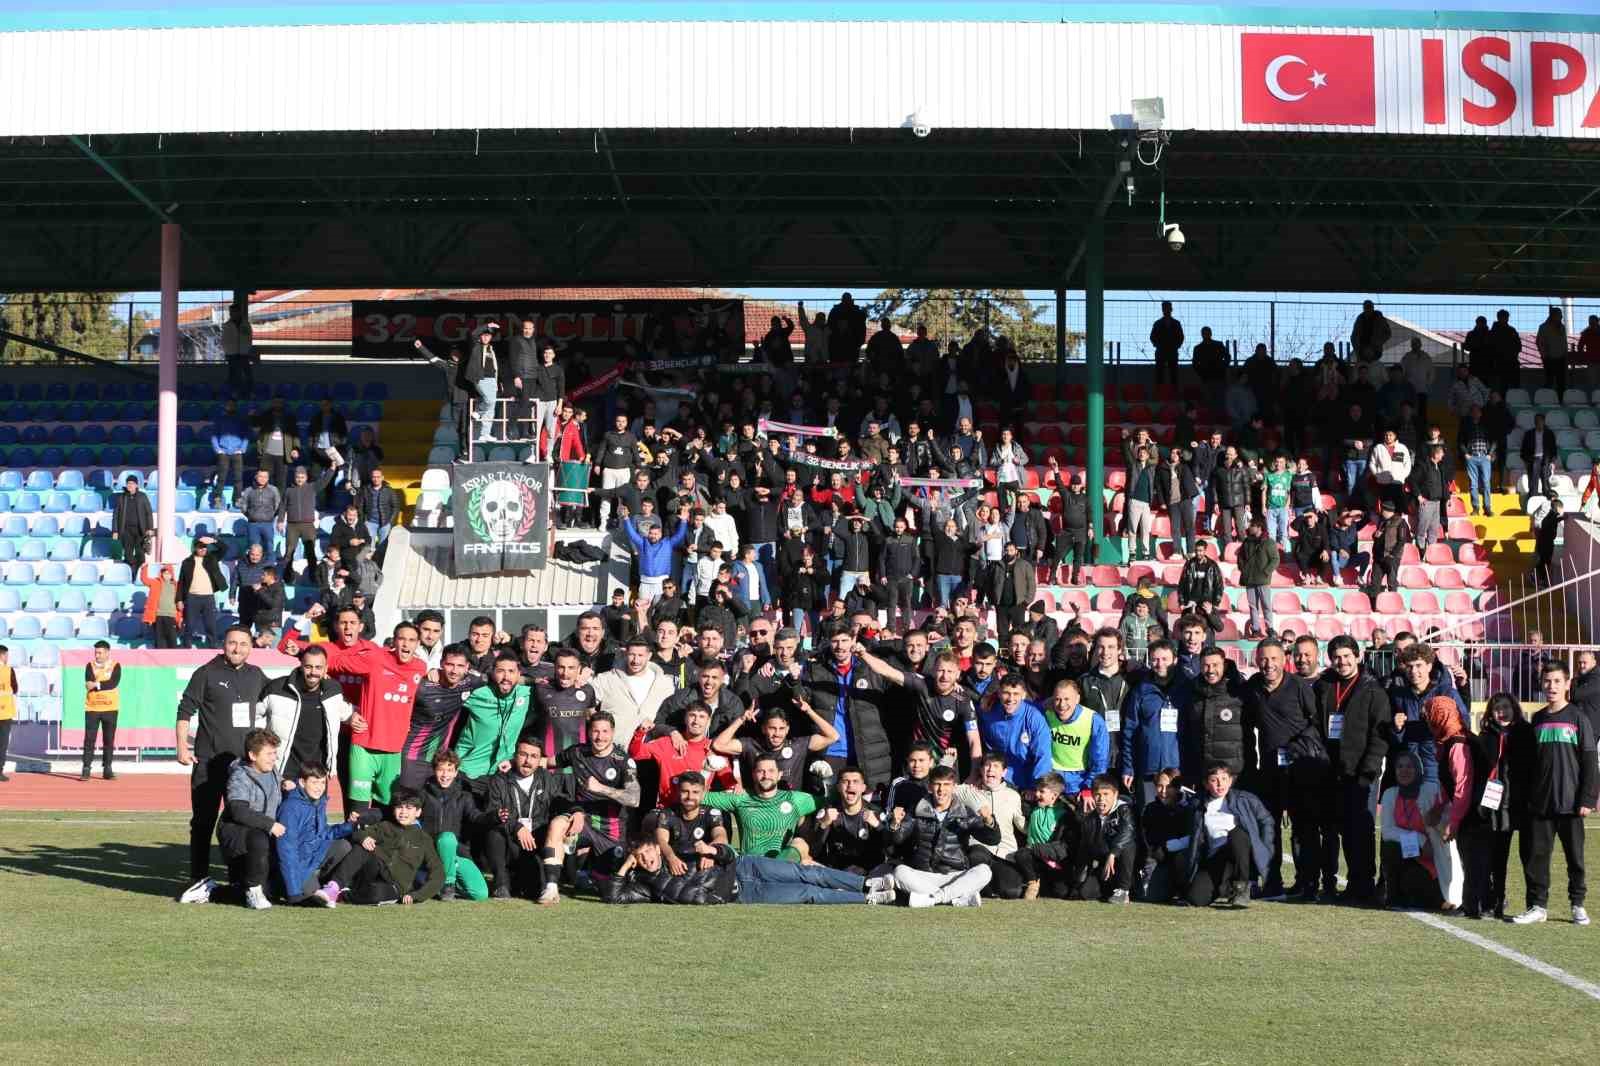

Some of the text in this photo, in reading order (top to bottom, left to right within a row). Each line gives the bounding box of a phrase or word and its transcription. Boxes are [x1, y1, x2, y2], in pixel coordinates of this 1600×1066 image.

[1421, 36, 1600, 128] ISP
[364, 313, 416, 344] 32
[806, 455, 819, 466] 32
[461, 471, 543, 494] ISPARTASPOR
[463, 542, 541, 556] FANATICS
